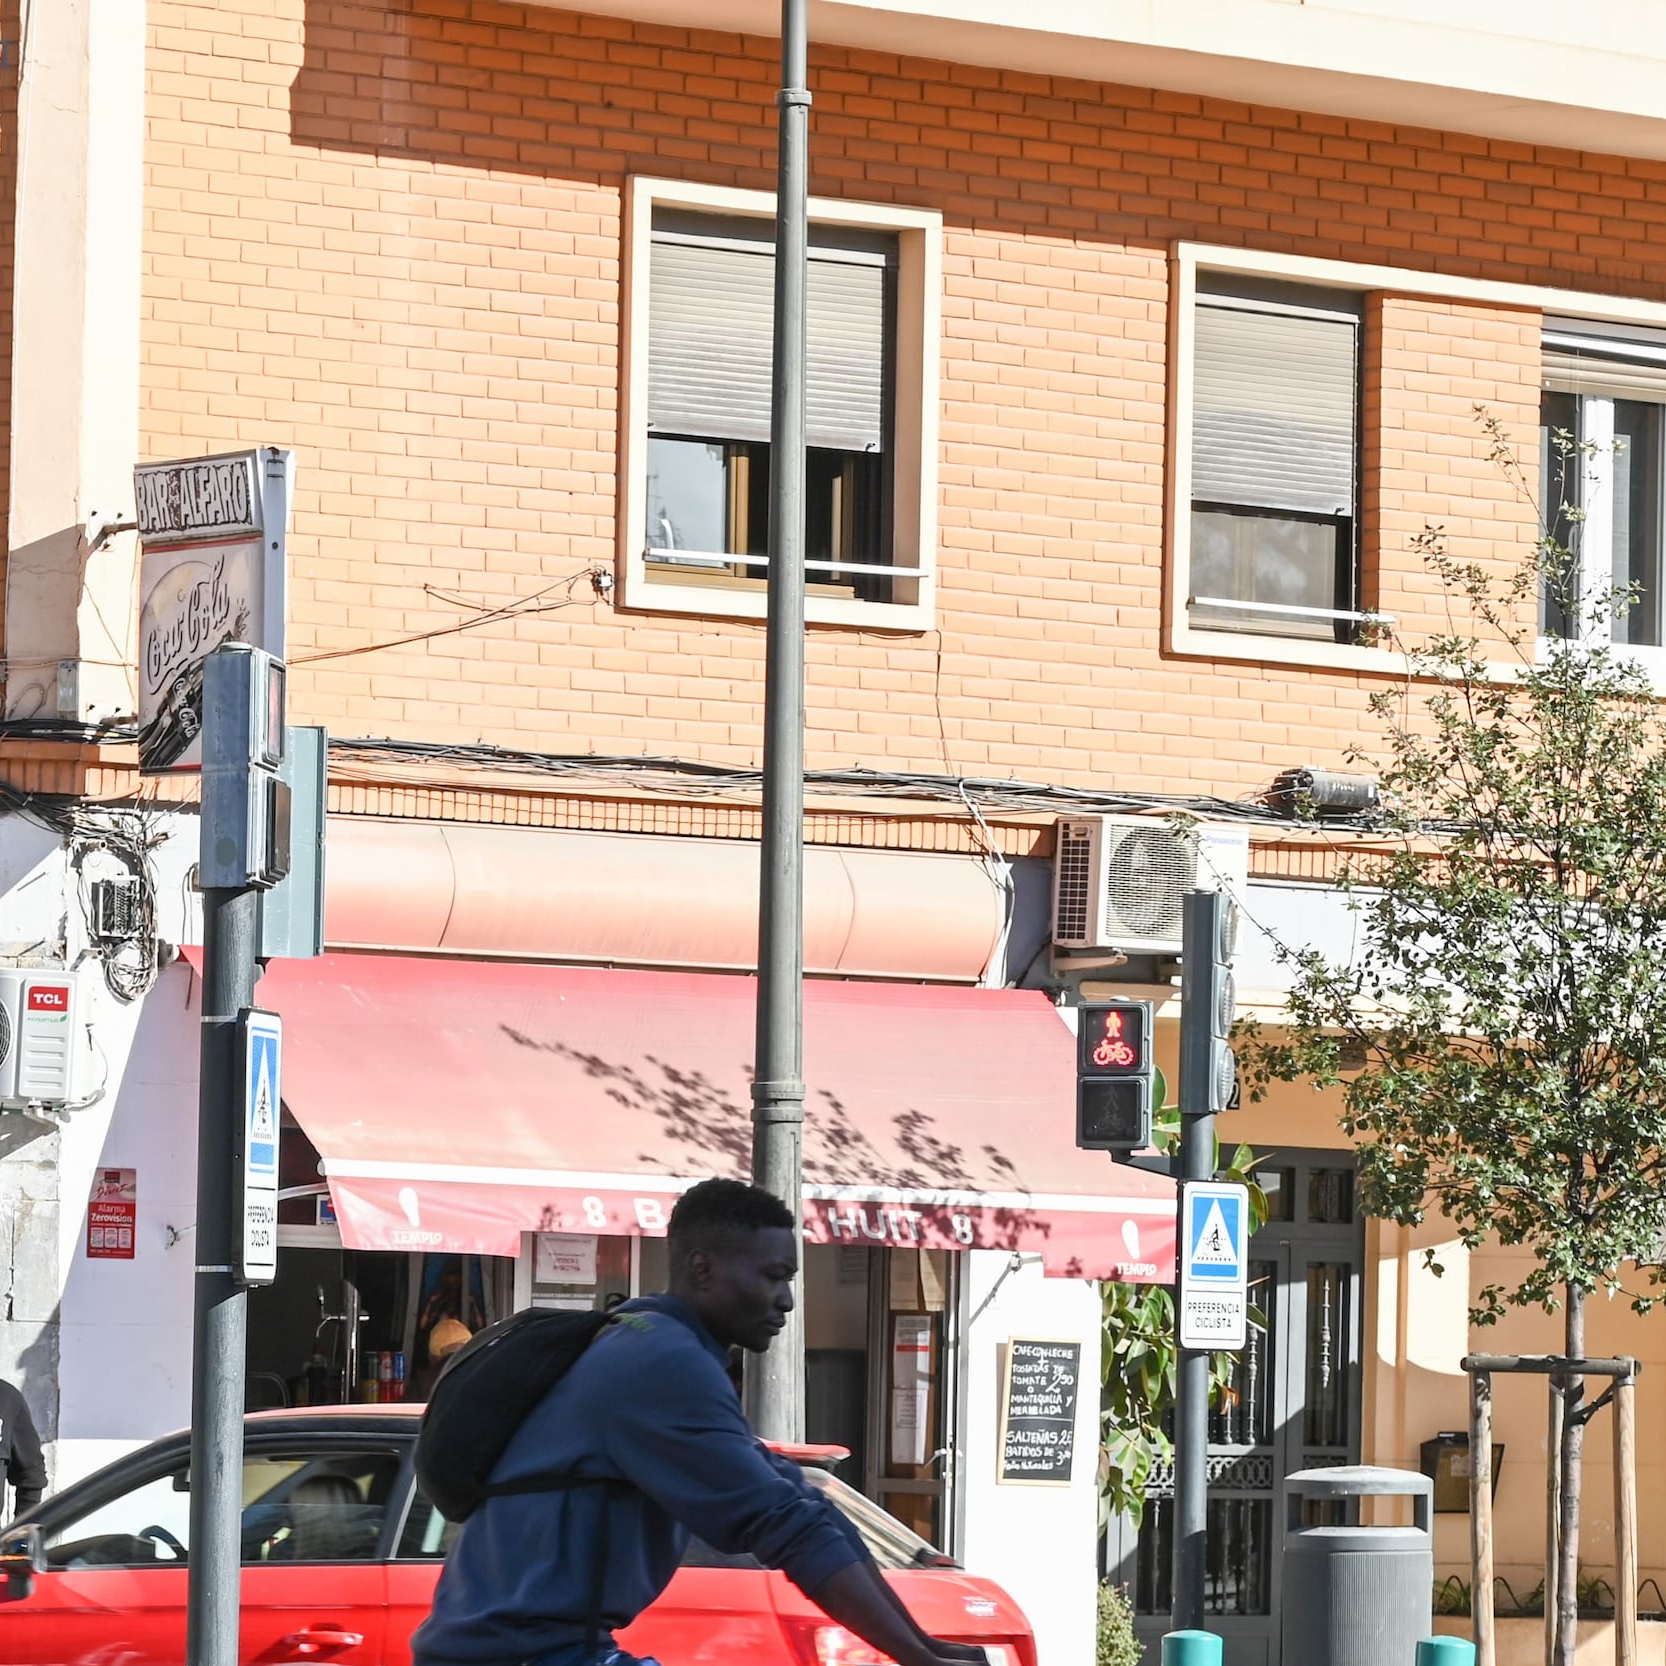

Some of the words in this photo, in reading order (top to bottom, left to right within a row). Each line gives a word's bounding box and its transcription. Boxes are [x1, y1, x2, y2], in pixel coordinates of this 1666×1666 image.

[136, 470, 172, 532] BAR
[179, 461, 253, 528] ALFARO
[33, 993, 63, 1005] TCL
[98, 1203, 126, 1213] Alarma
[91, 1212, 133, 1224] Zerovision
[583, 1196, 607, 1228] 8
[830, 1207, 923, 1241] HUIT
[952, 1214, 974, 1244] 8
[390, 1230, 443, 1245] TEMPLO
[1116, 1261, 1157, 1276] TEMPLO
[1188, 1301, 1240, 1314] PREFERENCIA
[1195, 1316, 1232, 1329] CICLISTA
[1006, 1428, 1058, 1445] SALTEÑAS
[1005, 1445, 1042, 1457] BATIDOS
